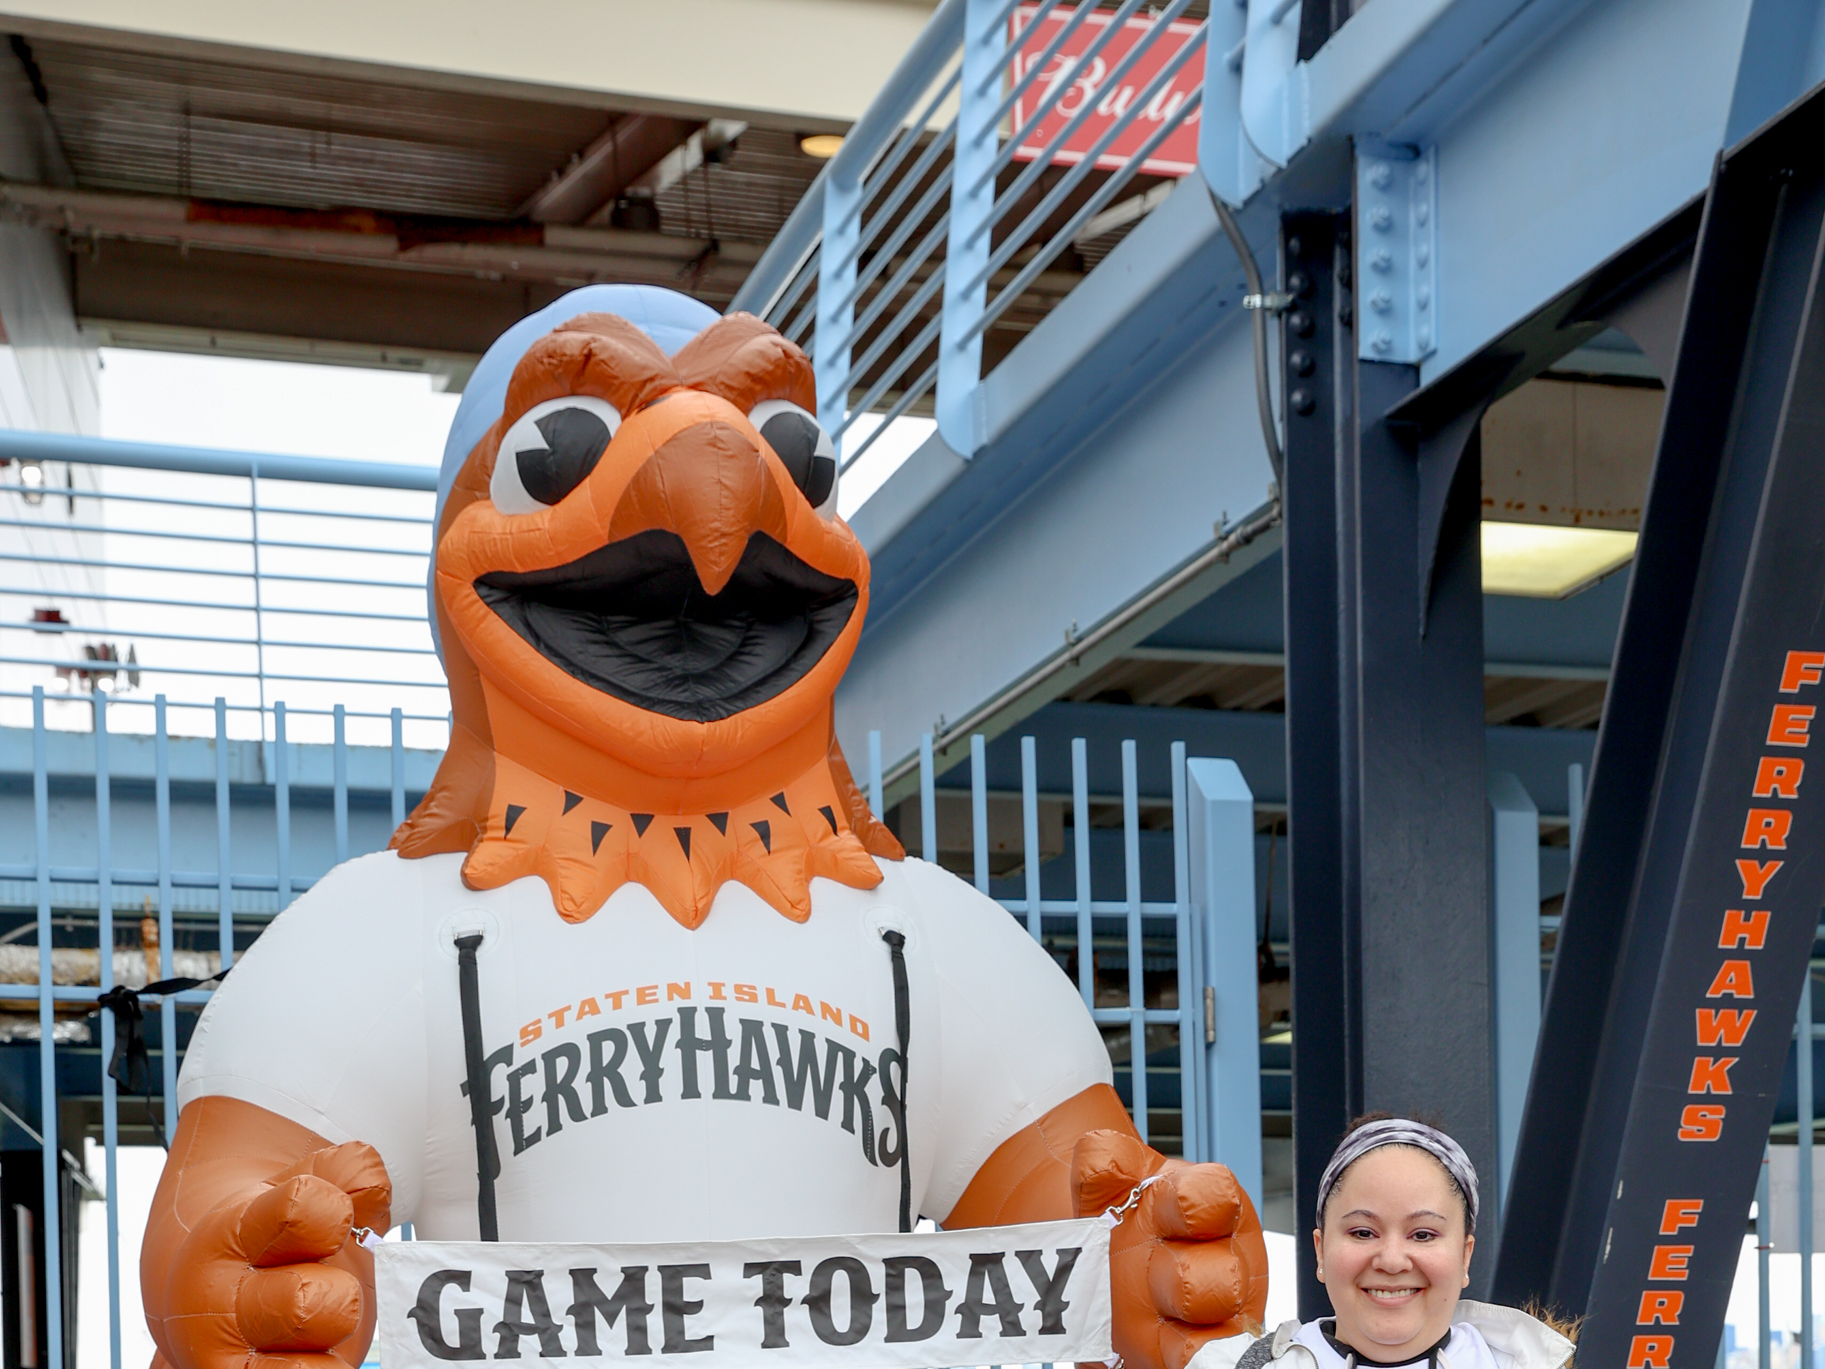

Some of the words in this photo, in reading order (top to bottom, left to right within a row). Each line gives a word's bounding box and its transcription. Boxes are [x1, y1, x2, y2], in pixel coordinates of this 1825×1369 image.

[1677, 650, 1825, 1142] FERRYHAWKS
[519, 981, 692, 1048] STATEN
[707, 981, 870, 1042] ISLAND
[407, 1264, 714, 1361] GAME
[743, 1247, 1083, 1350] TODAY
